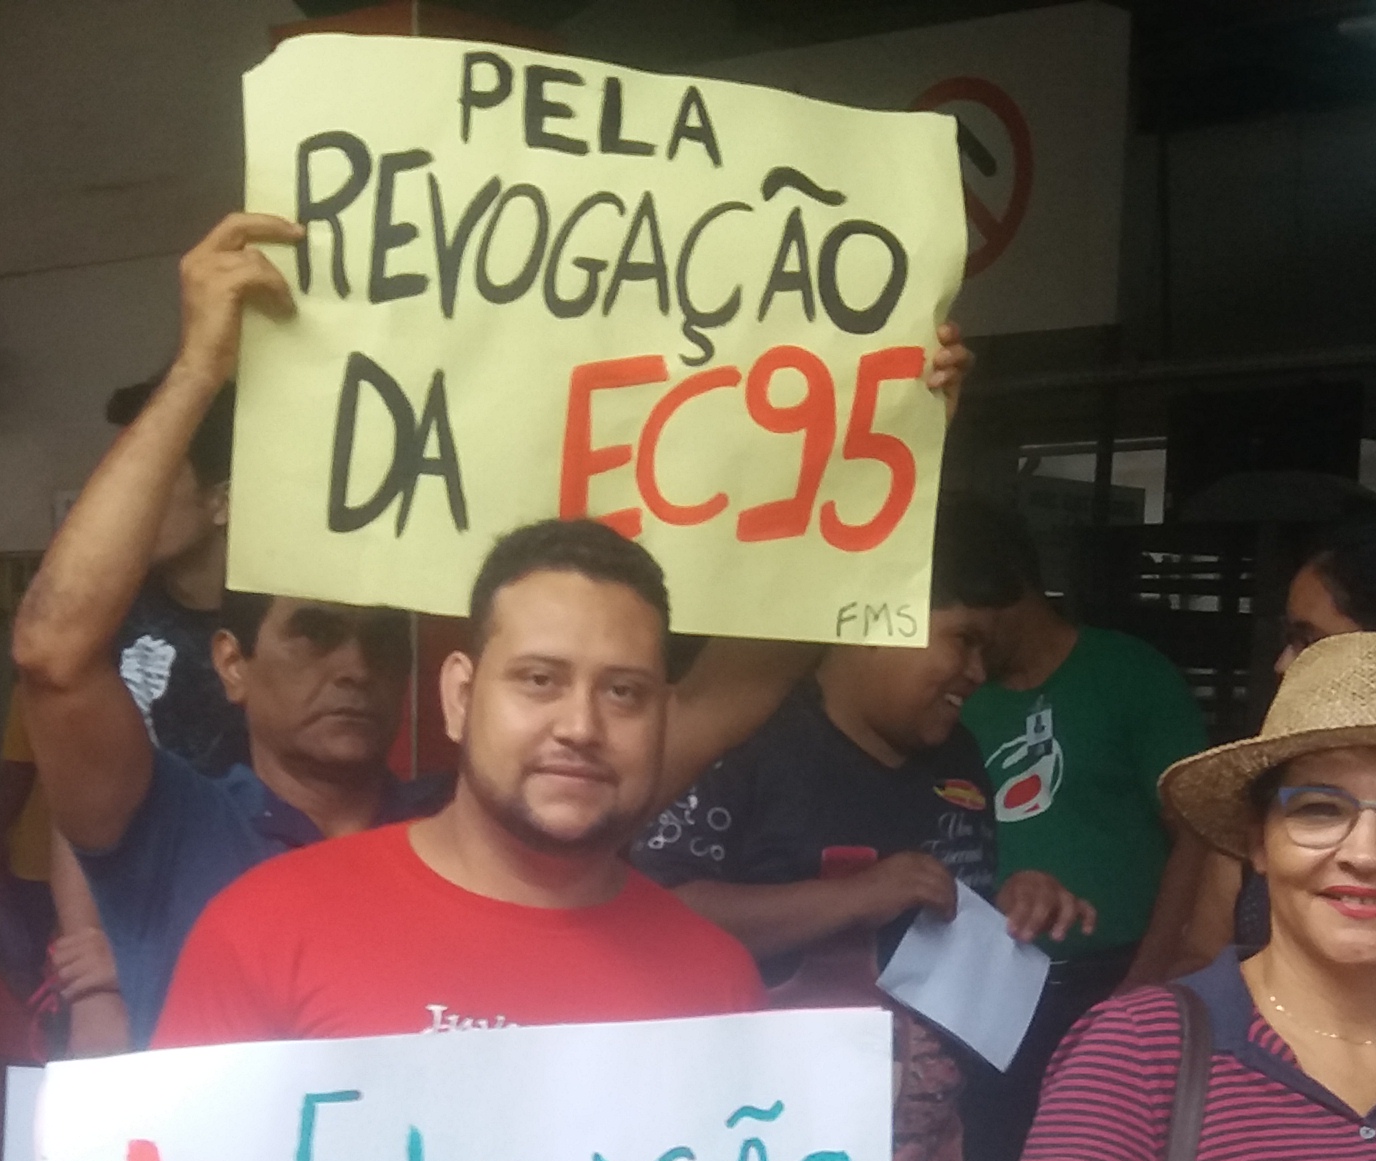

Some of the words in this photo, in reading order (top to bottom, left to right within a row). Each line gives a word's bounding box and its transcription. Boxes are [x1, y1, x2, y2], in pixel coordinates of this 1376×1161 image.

[459, 51, 721, 167] PELA
[295, 130, 908, 367] REVOGAÇÃO
[327, 352, 468, 537] DA
[559, 345, 925, 552] EC95
[836, 603, 917, 639] FMS
